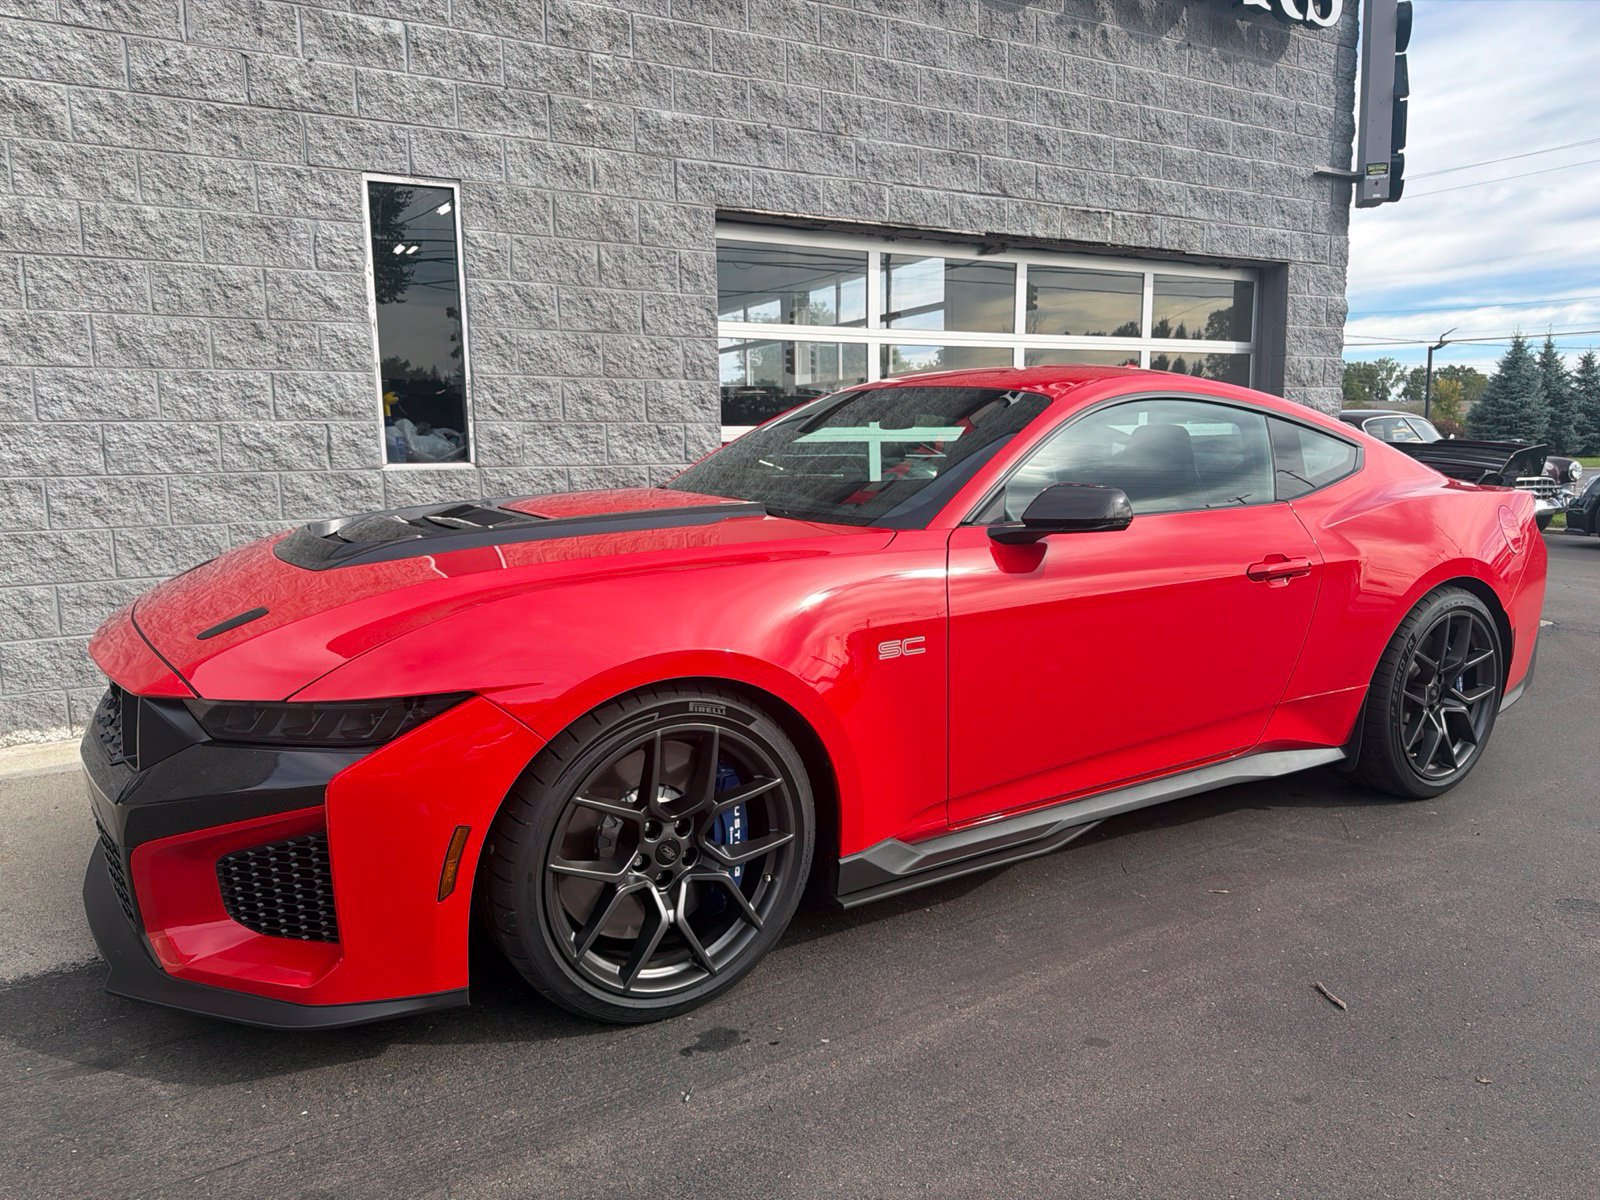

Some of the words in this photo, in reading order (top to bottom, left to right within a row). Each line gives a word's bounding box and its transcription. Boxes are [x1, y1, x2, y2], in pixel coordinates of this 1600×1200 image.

[878, 636, 926, 660] SC
[1392, 660, 1406, 704] ZERO
[689, 702, 727, 716] PIRELLI
